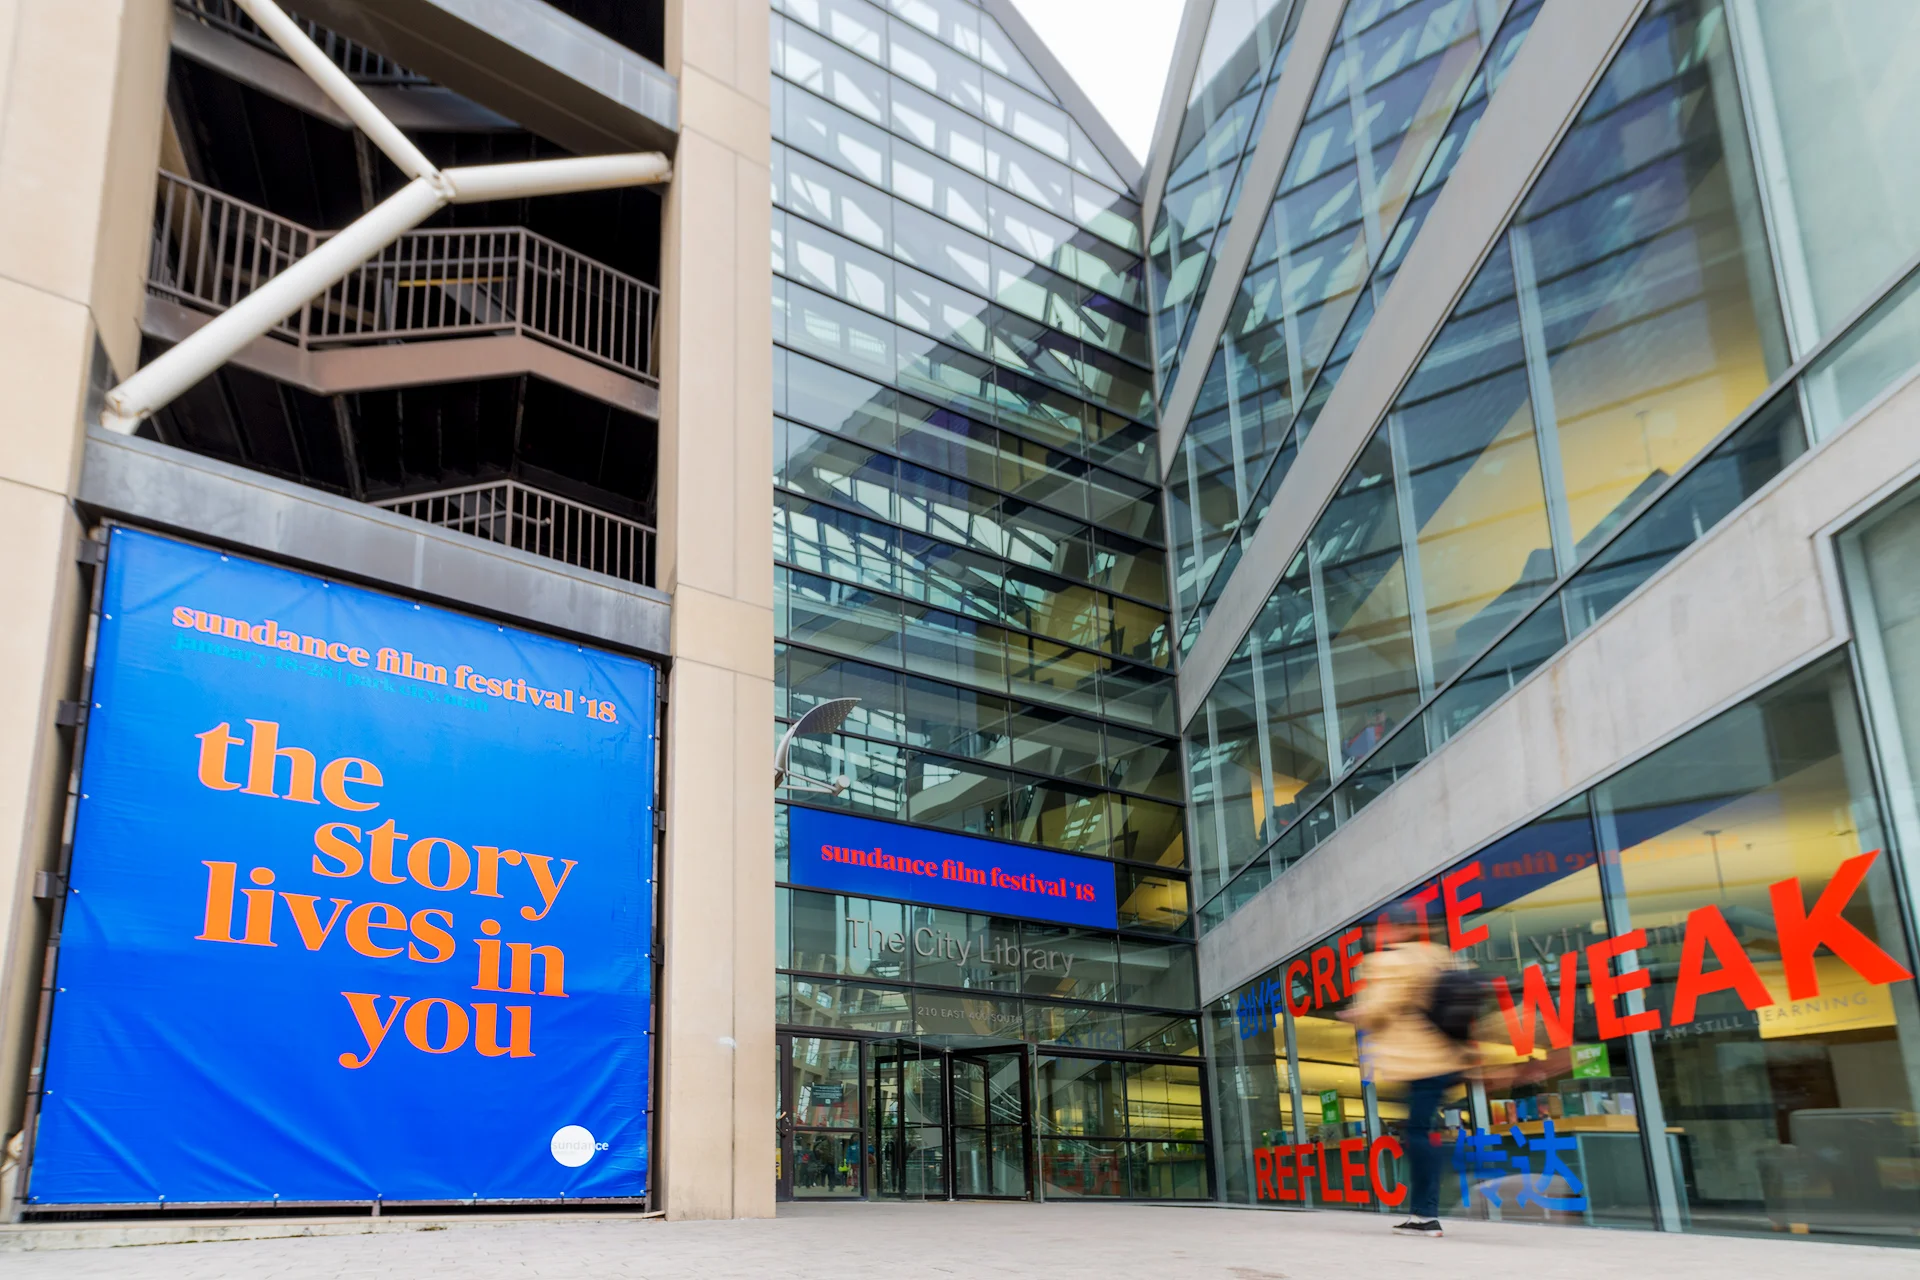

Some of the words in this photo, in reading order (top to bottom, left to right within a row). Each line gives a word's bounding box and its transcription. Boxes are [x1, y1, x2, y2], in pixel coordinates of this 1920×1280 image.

[170, 631, 271, 669] january
[275, 655, 333, 680] 18-28
[345, 672, 396, 693] park
[400, 682, 440, 704] city,
[444, 693, 489, 712] utah
[172, 605, 370, 668] sundance
[375, 647, 449, 687] film
[453, 665, 575, 714] festival
[195, 718, 384, 812] the
[312, 818, 578, 921] story
[821, 845, 938, 877] sundance
[942, 859, 987, 885] film
[990, 867, 1067, 898] festival
[194, 860, 456, 964] lives
[471, 918, 569, 998] in
[846, 917, 905, 953] The
[914, 927, 971, 967] City
[979, 934, 1074, 978] Library
[338, 991, 536, 1069] you
[917, 1006, 938, 1016] 210
[941, 1008, 965, 1019] EAST
[1663, 1025, 1688, 1041] AM
[1695, 1016, 1744, 1035] STILL
[1751, 991, 1870, 1026] LEARNING
[553, 1141, 609, 1151] sundance
[1452, 1120, 1587, 1212] 传达
